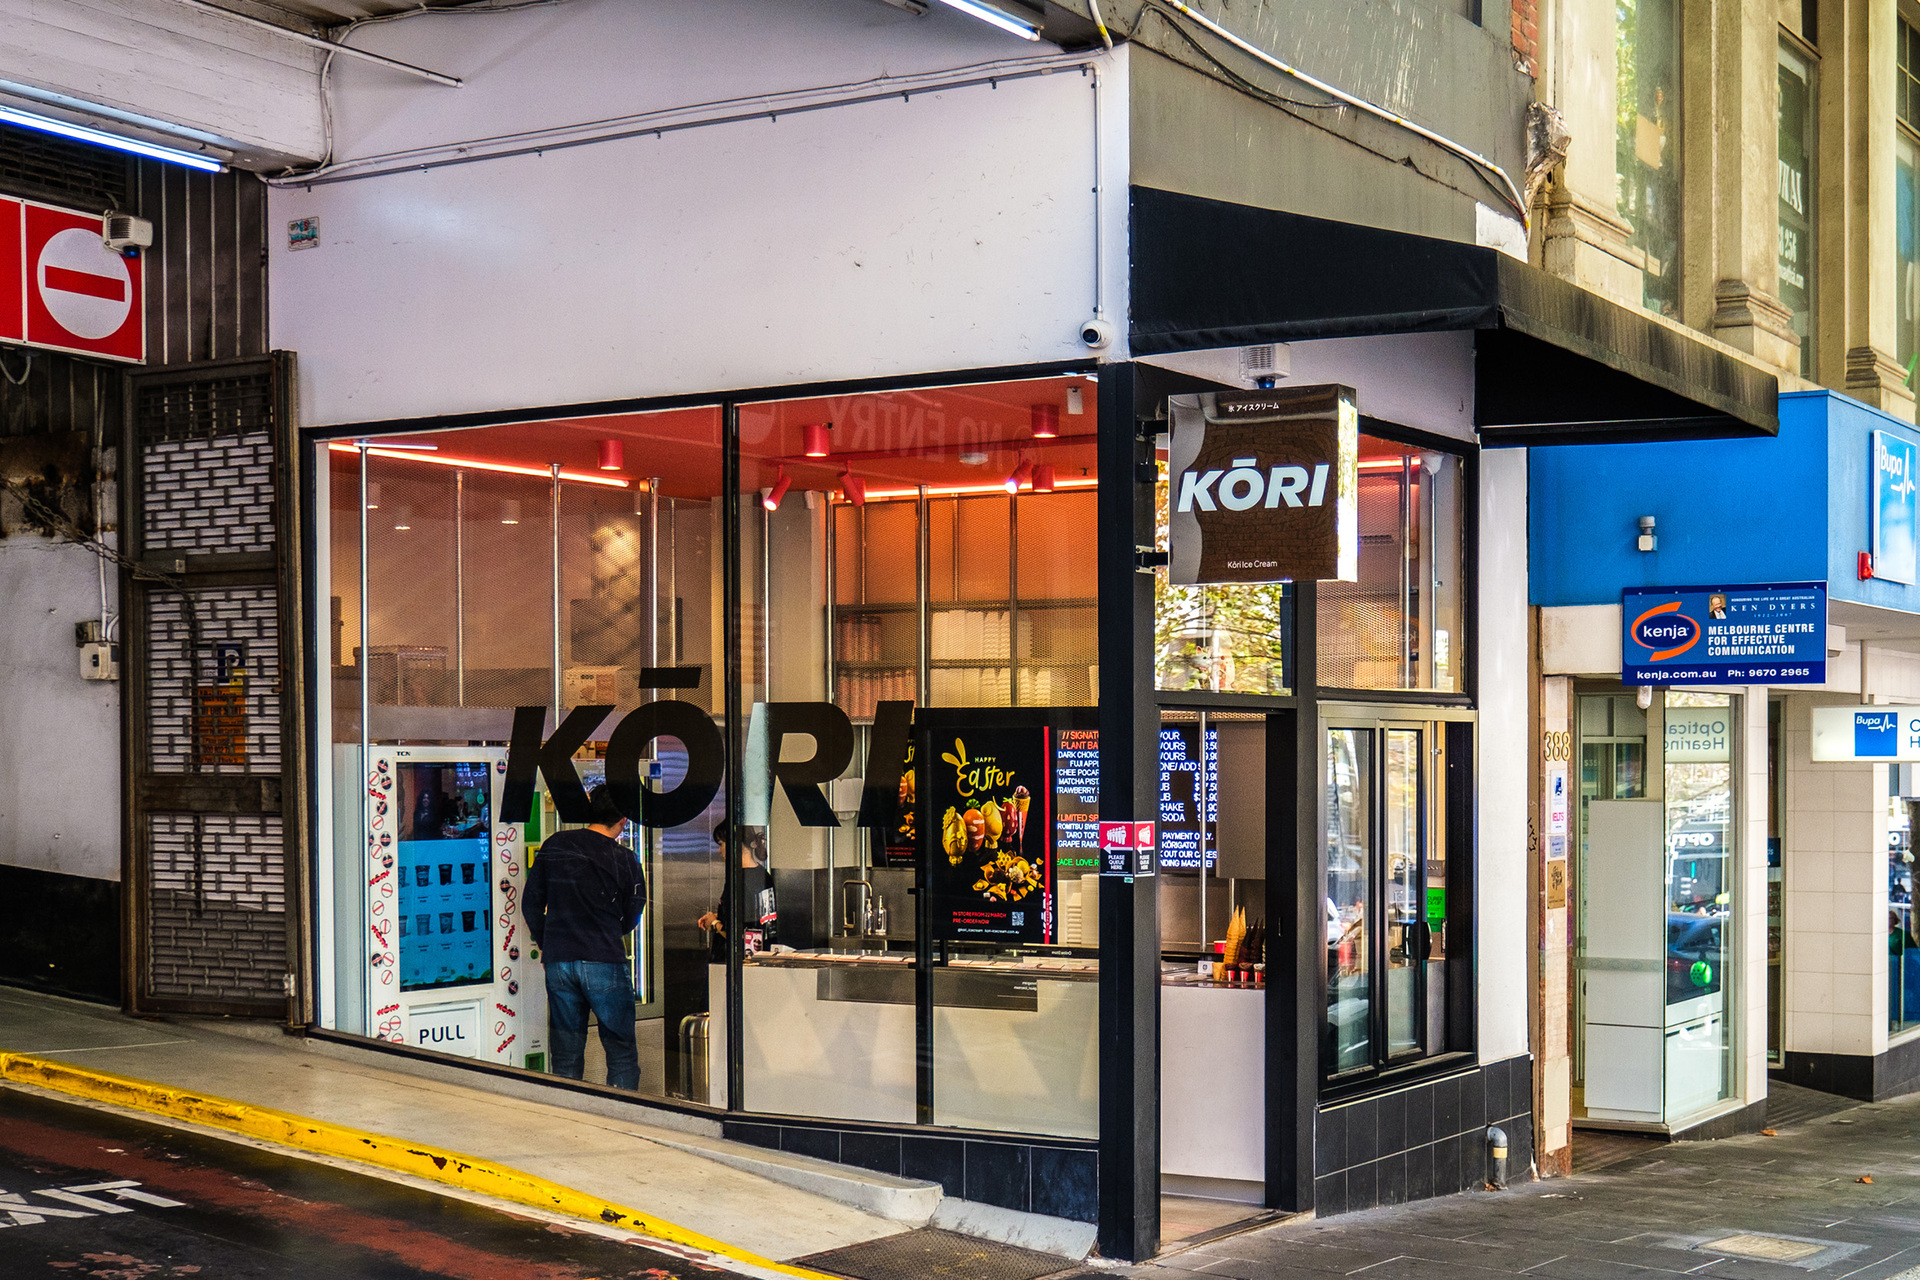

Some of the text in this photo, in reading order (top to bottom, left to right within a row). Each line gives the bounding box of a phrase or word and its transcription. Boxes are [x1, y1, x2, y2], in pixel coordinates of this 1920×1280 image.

[1236, 402, 1279, 412] アイスクリーム
[1880, 444, 1902, 479] Bupa
[1178, 458, 1329, 513] KŌRI
[1643, 625, 1688, 639] kenja
[1708, 624, 1814, 635] MELBOURNE CENTRE
[1708, 635, 1785, 645] FOR EFFECTIVE
[1708, 645, 1795, 656] COMMUNICATION
[1637, 671, 1716, 680] kenja.com.au
[1856, 716, 1880, 726] Bupa
[500, 667, 914, 828] KŌRI
[1061, 741, 1086, 749] PLANT
[1544, 731, 1570, 761] 388
[1179, 762, 1197, 770] ADD
[956, 762, 1015, 797] Easter
[1162, 813, 1185, 822] SODA
[1553, 812, 1564, 821] IELTS
[420, 1025, 465, 1044] PULL
